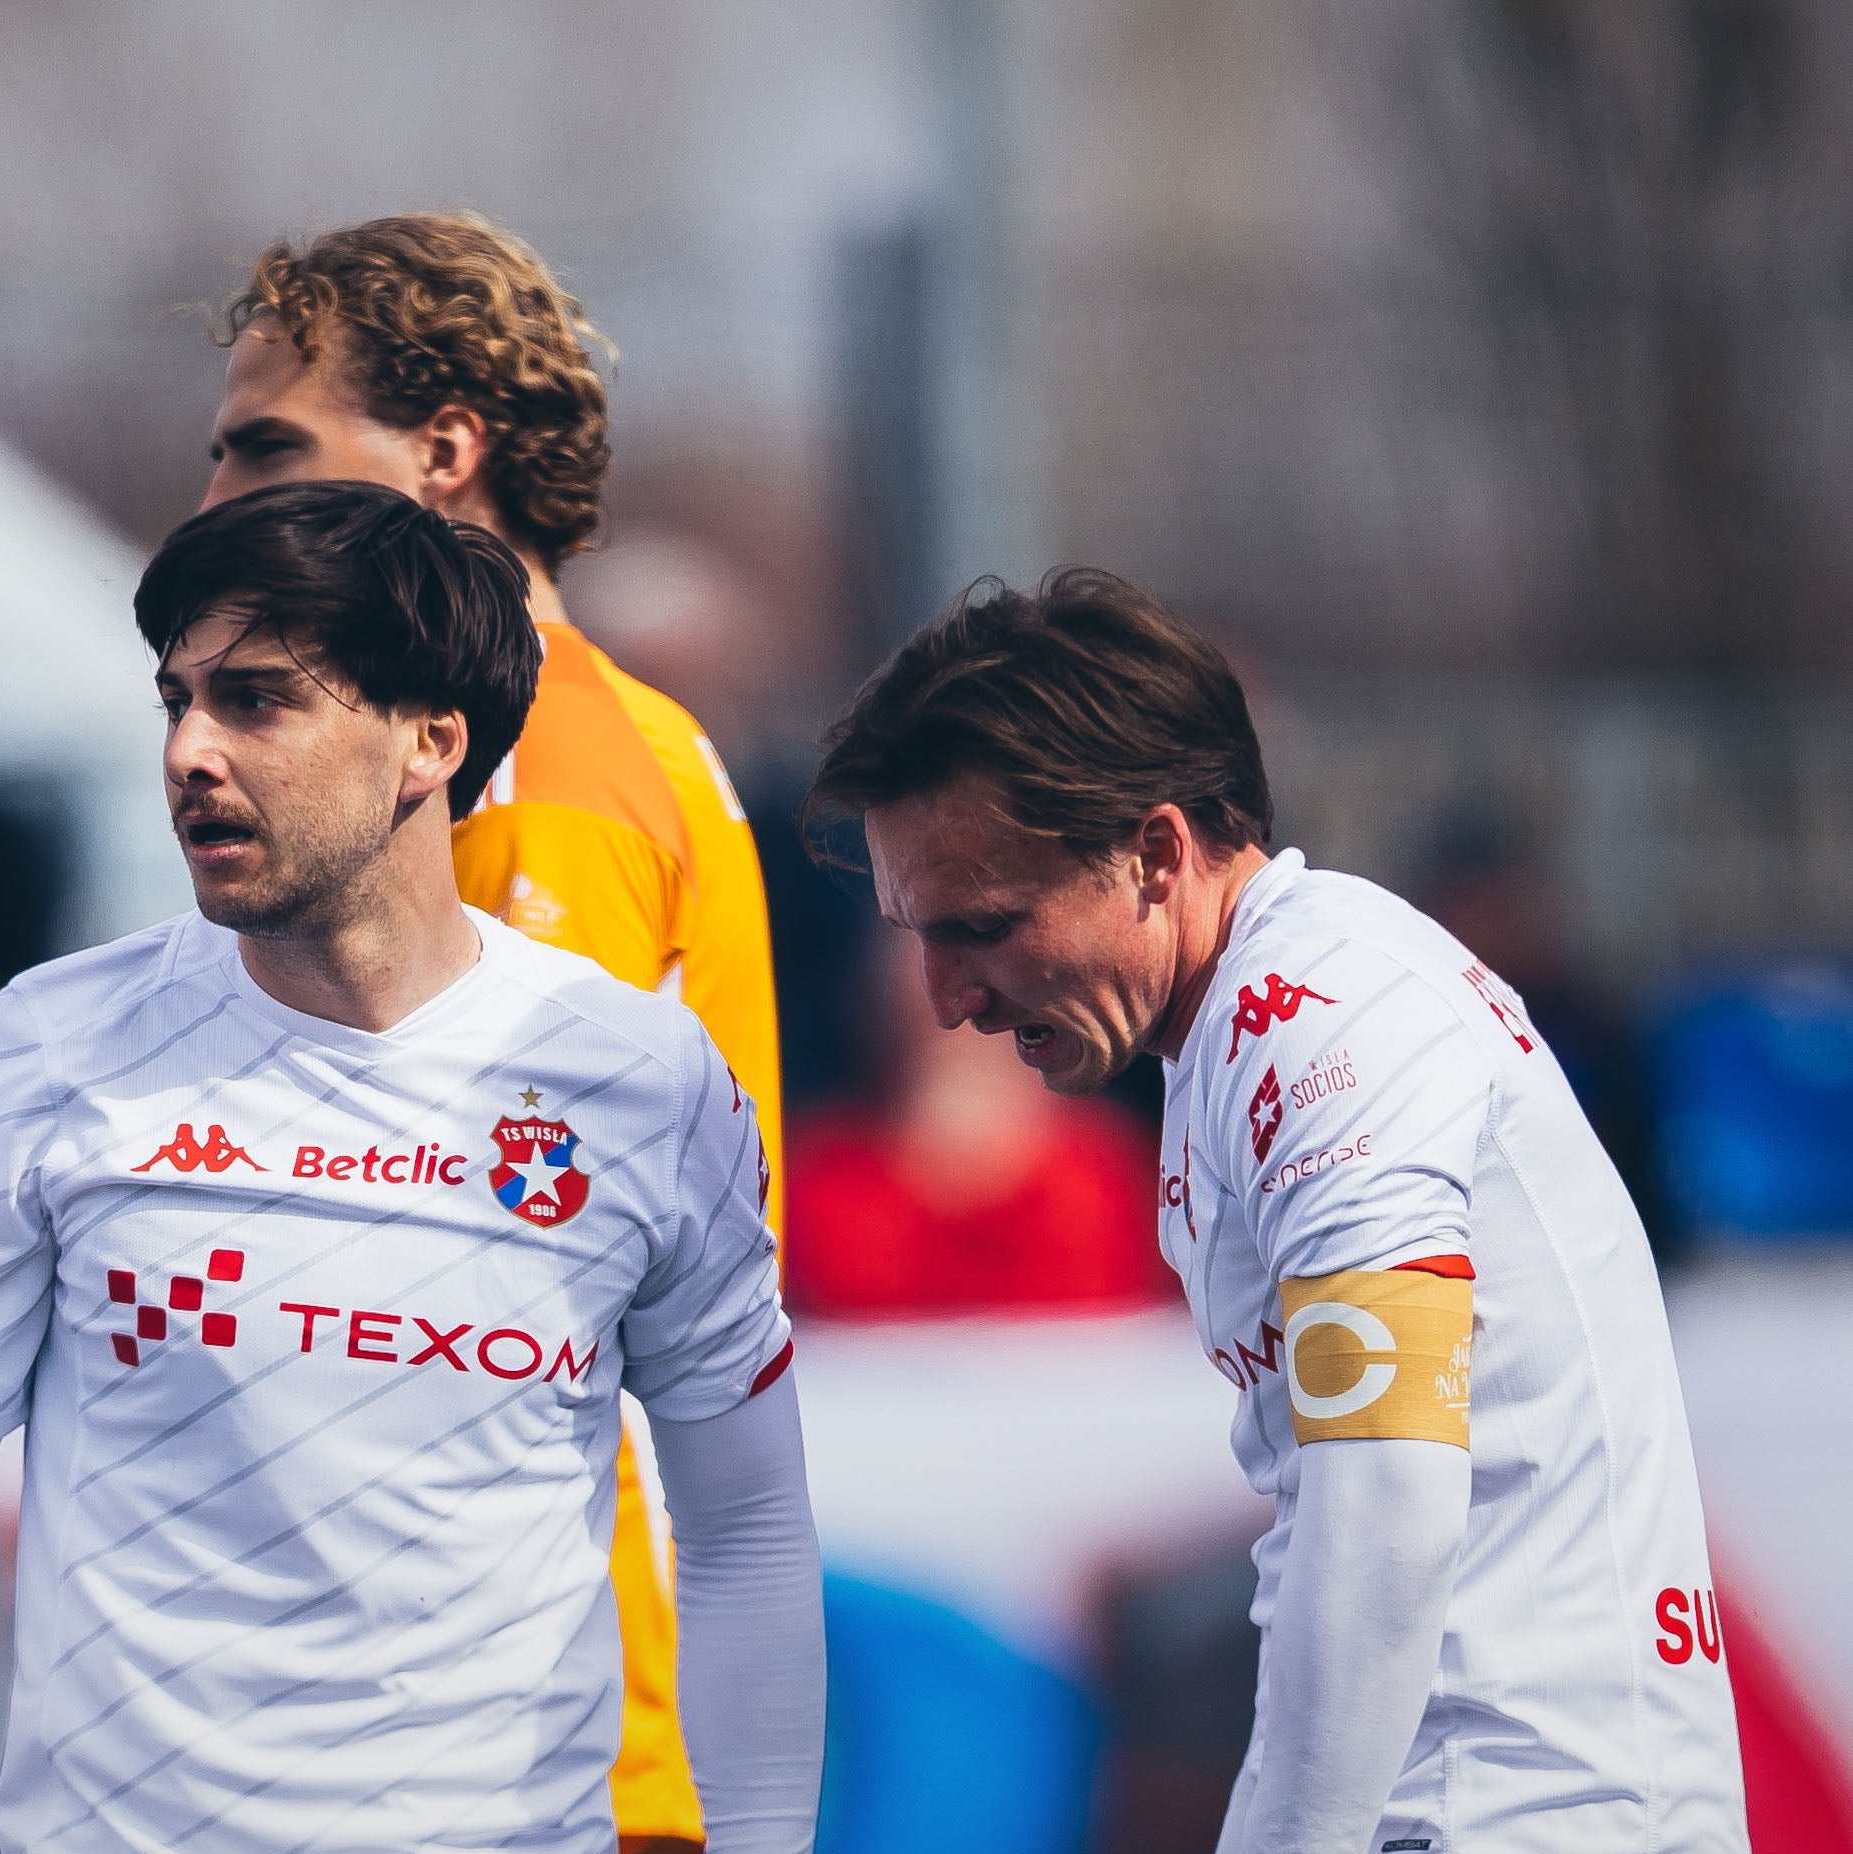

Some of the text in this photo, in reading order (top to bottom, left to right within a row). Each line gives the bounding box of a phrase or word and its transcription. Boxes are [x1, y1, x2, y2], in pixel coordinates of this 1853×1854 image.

[1290, 1062, 1357, 1110] SOCIOS
[500, 1125, 568, 1146] TS WISŁA
[292, 1142, 469, 1186] Betclic
[279, 1302, 601, 1385] TEXOM
[1284, 1302, 1398, 1419] C
